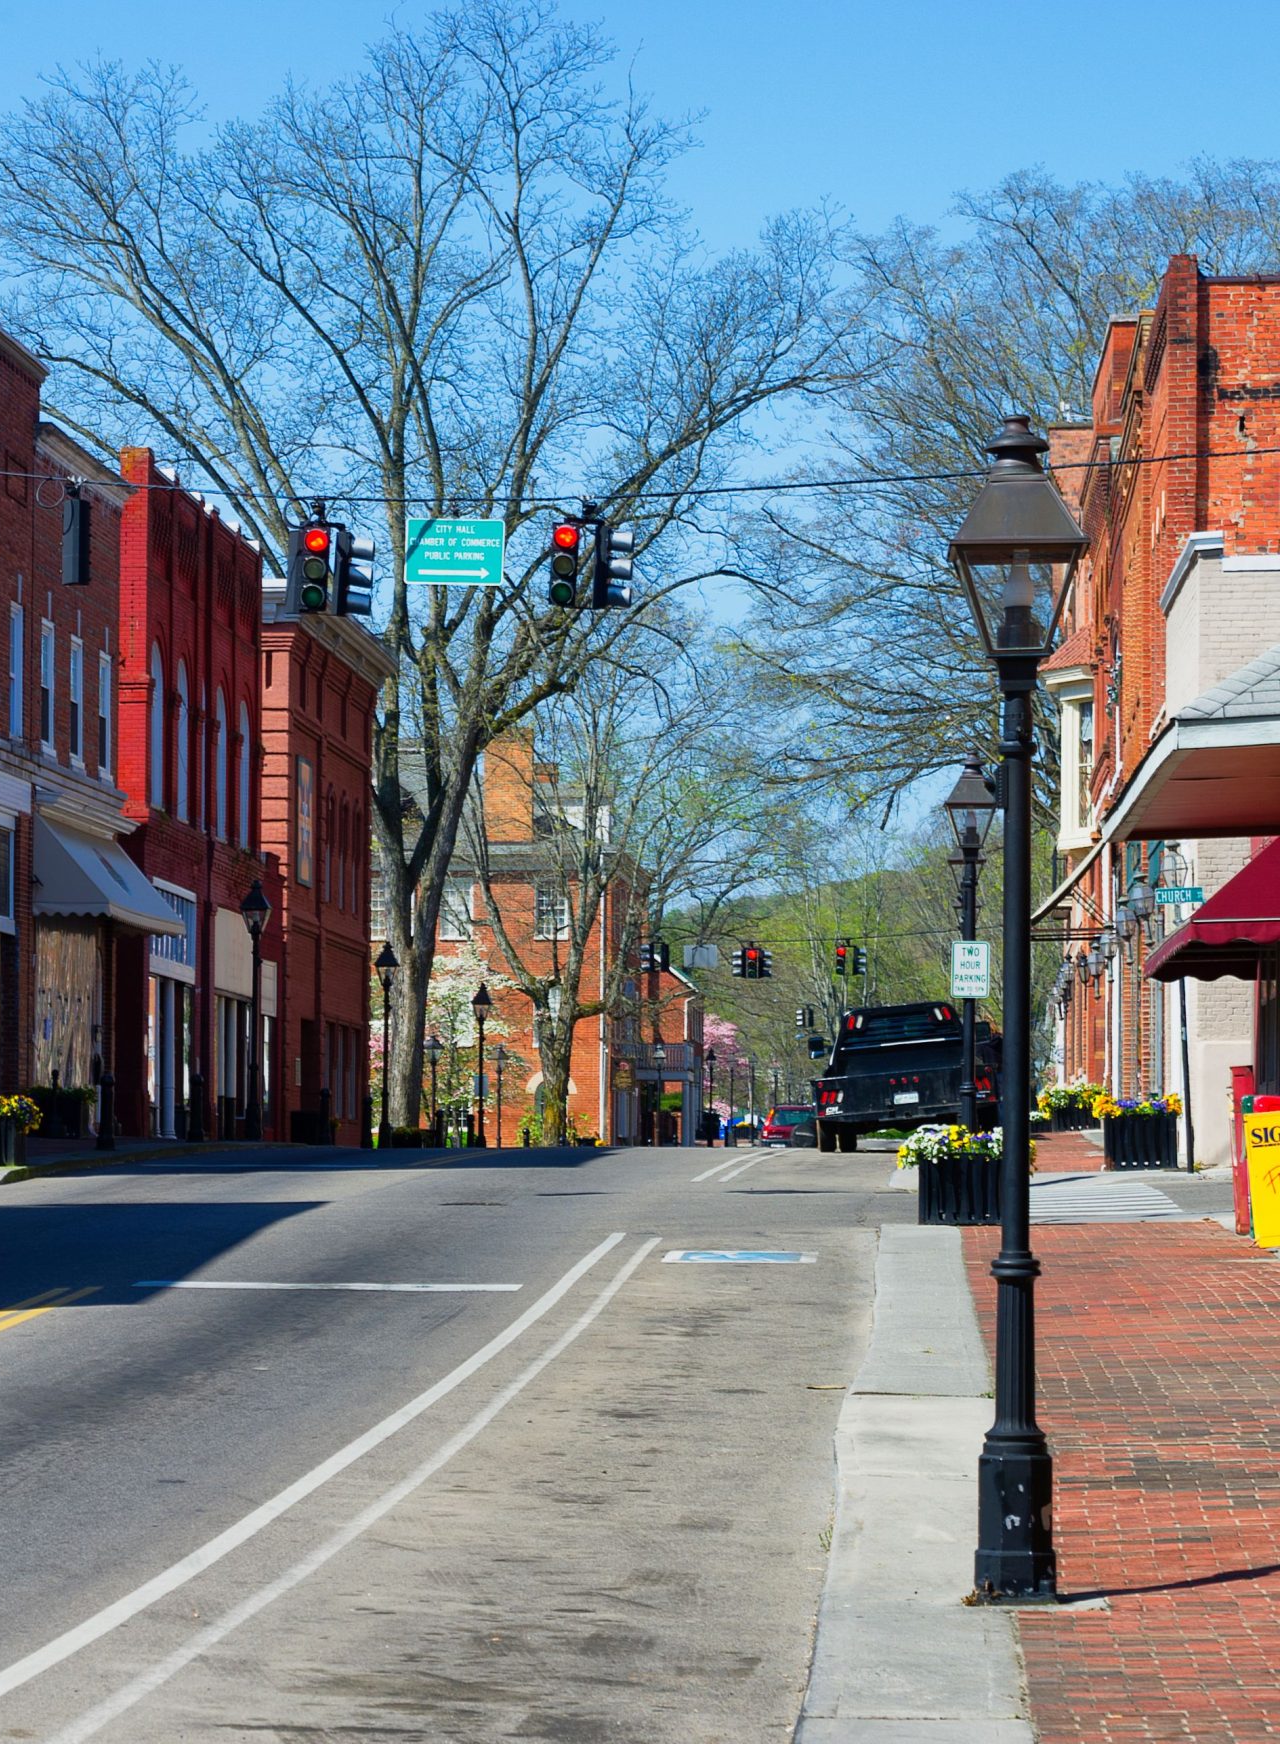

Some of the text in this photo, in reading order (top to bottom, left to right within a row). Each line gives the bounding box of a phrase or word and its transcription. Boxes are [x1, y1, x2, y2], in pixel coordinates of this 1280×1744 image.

[436, 525, 475, 534] CITY HALL
[448, 538, 457, 546] OF
[461, 538, 501, 548] COMMERCE
[424, 551, 485, 561] PUBLIC PARKING
[1156, 889, 1192, 903] CHURCH
[961, 947, 980, 957] TWO
[959, 960, 981, 969] HOUR
[954, 974, 986, 983] PARKING
